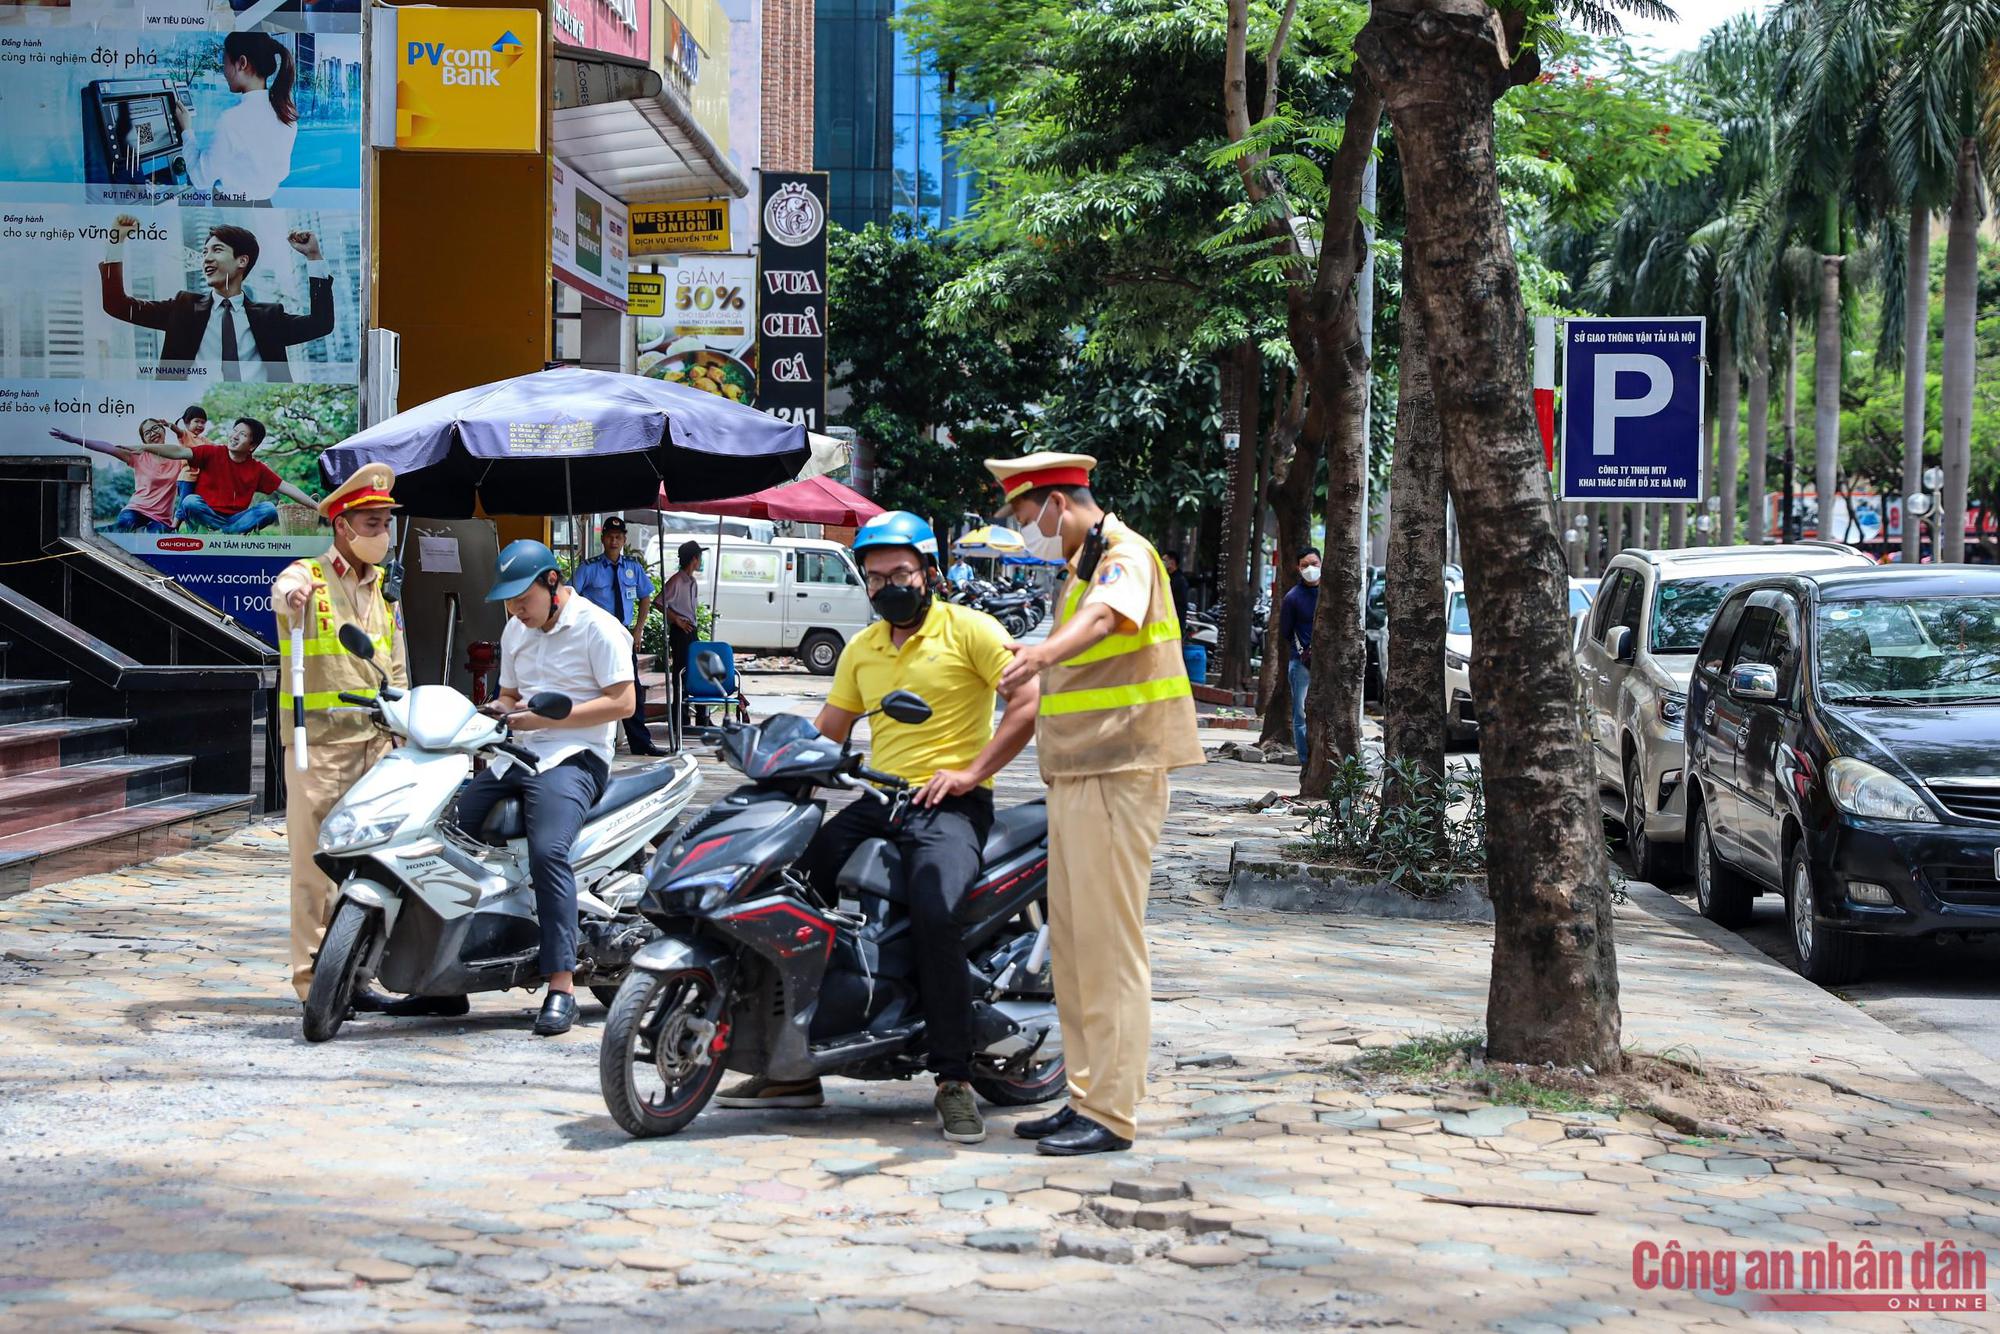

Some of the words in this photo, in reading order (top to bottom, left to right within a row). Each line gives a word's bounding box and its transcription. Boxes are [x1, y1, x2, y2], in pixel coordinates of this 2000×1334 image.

[147, 16, 161, 24] VAY
[164, 15, 179, 24] TIÊU
[181, 16, 205, 25] DÙNG
[1, 39, 21, 48] Đồng
[23, 39, 42, 47] hành
[1, 53, 26, 64] cùng
[29, 53, 46, 63] trải
[50, 53, 87, 65] nghiệm
[91, 46, 118, 67] đột
[125, 47, 157, 69] phá
[408, 42, 491, 66] PVcom
[442, 66, 500, 86] Bank
[103, 190, 118, 199] RÚT
[120, 190, 136, 200] TIỀN
[139, 190, 161, 200] BẰNG
[163, 192, 175, 201] QR
[182, 191, 212, 201] KHÔNG
[214, 192, 230, 201] CẦN
[233, 191, 247, 201] THẺ
[4, 215, 23, 224] Đồng
[25, 215, 44, 223] hành
[633, 210, 707, 224] WESTERN
[4, 227, 21, 238] cho
[25, 230, 36, 240] sự
[40, 228, 74, 241] nghiệp
[79, 225, 120, 244] vững
[127, 222, 168, 240] chắc
[657, 220, 707, 233] UNION
[635, 237, 654, 246] DỊCH
[656, 237, 666, 246] VỤ
[668, 233, 699, 244] CHUYỂN
[703, 233, 719, 241] TIỀN
[677, 267, 725, 285] GIẢM
[764, 270, 823, 294] VUA
[675, 286, 745, 311] 50%
[762, 306, 823, 337] CHẢ
[1574, 330, 1585, 343] SỞ
[1587, 333, 1606, 343] GIAO
[1608, 331, 1634, 343] THÔNG
[1636, 331, 1652, 344] VẬN
[1654, 329, 1667, 343] TẢI
[1669, 331, 1680, 343] HÀ
[1681, 331, 1696, 344] NỘI
[138, 366, 153, 374] VAY
[156, 367, 185, 375] NHANH
[187, 367, 207, 375] SMES
[772, 352, 812, 382] CÁ
[0, 390, 19, 398] Đồng
[21, 390, 39, 398] hành
[0, 401, 12, 412] để
[15, 402, 35, 412] bảo
[39, 403, 50, 414] vệ
[55, 397, 91, 413] toàn
[98, 396, 134, 418] diện
[1593, 354, 1674, 455] P
[1598, 465, 1618, 475] CÔNG
[1620, 466, 1629, 475] TY
[1631, 466, 1650, 475] TNHH
[1651, 466, 1667, 475] MTV
[1579, 479, 1595, 487] KHAI
[1597, 478, 1616, 487] THÁC
[1618, 476, 1636, 487] ĐIỂM
[1638, 476, 1648, 487] ĐỖ
[1650, 479, 1660, 487] XE
[1662, 477, 1671, 487] HÀ
[1673, 478, 1686, 489] NỘI
[209, 541, 222, 549] AN
[223, 541, 239, 550] TÂM
[240, 541, 265, 550] HƯNG
[267, 542, 291, 552] THỊNH
[233, 595, 272, 612] 1900
[405, 860, 437, 871] HONDA
